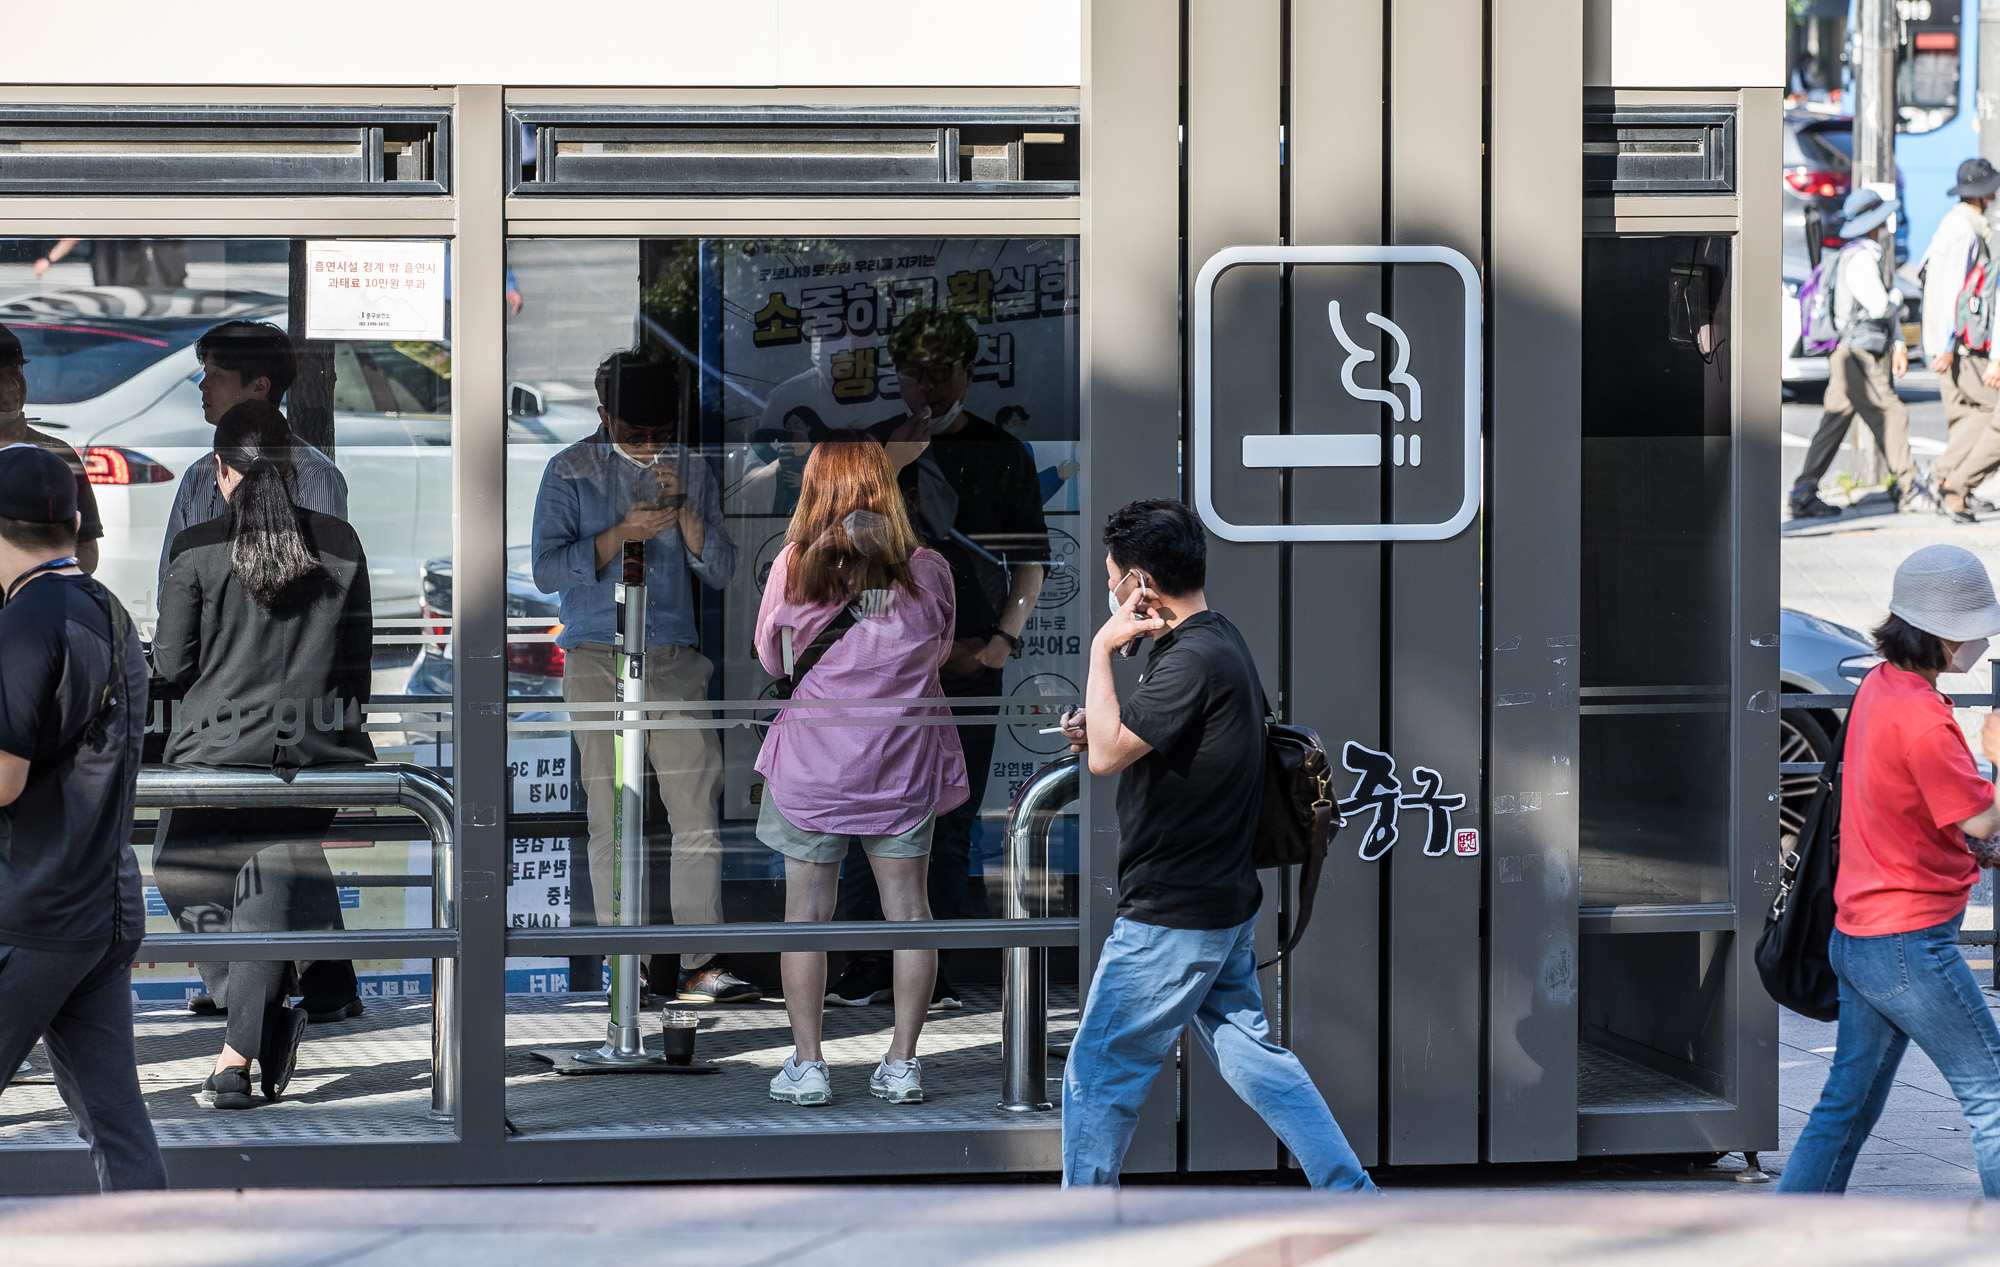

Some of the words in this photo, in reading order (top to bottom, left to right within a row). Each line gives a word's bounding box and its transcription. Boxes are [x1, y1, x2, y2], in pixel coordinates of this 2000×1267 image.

[314, 260, 358, 273] 흡연시설
[363, 261, 384, 273] 경계
[389, 262, 399, 274] 밖
[404, 262, 436, 274] 흡연시
[854, 257, 893, 273] 우리를
[895, 254, 936, 270] 지키는
[328, 277, 361, 289] 과태료
[365, 278, 399, 289] 10만원
[404, 278, 426, 290] 부과
[753, 276, 939, 348] 소중하고
[947, 259, 1080, 323] 확실한
[366, 312, 391, 320] 중구보건소
[1026, 616, 1067, 631] 비누로
[993, 762, 1034, 777] 감염병
[1338, 741, 1466, 862] 중구
